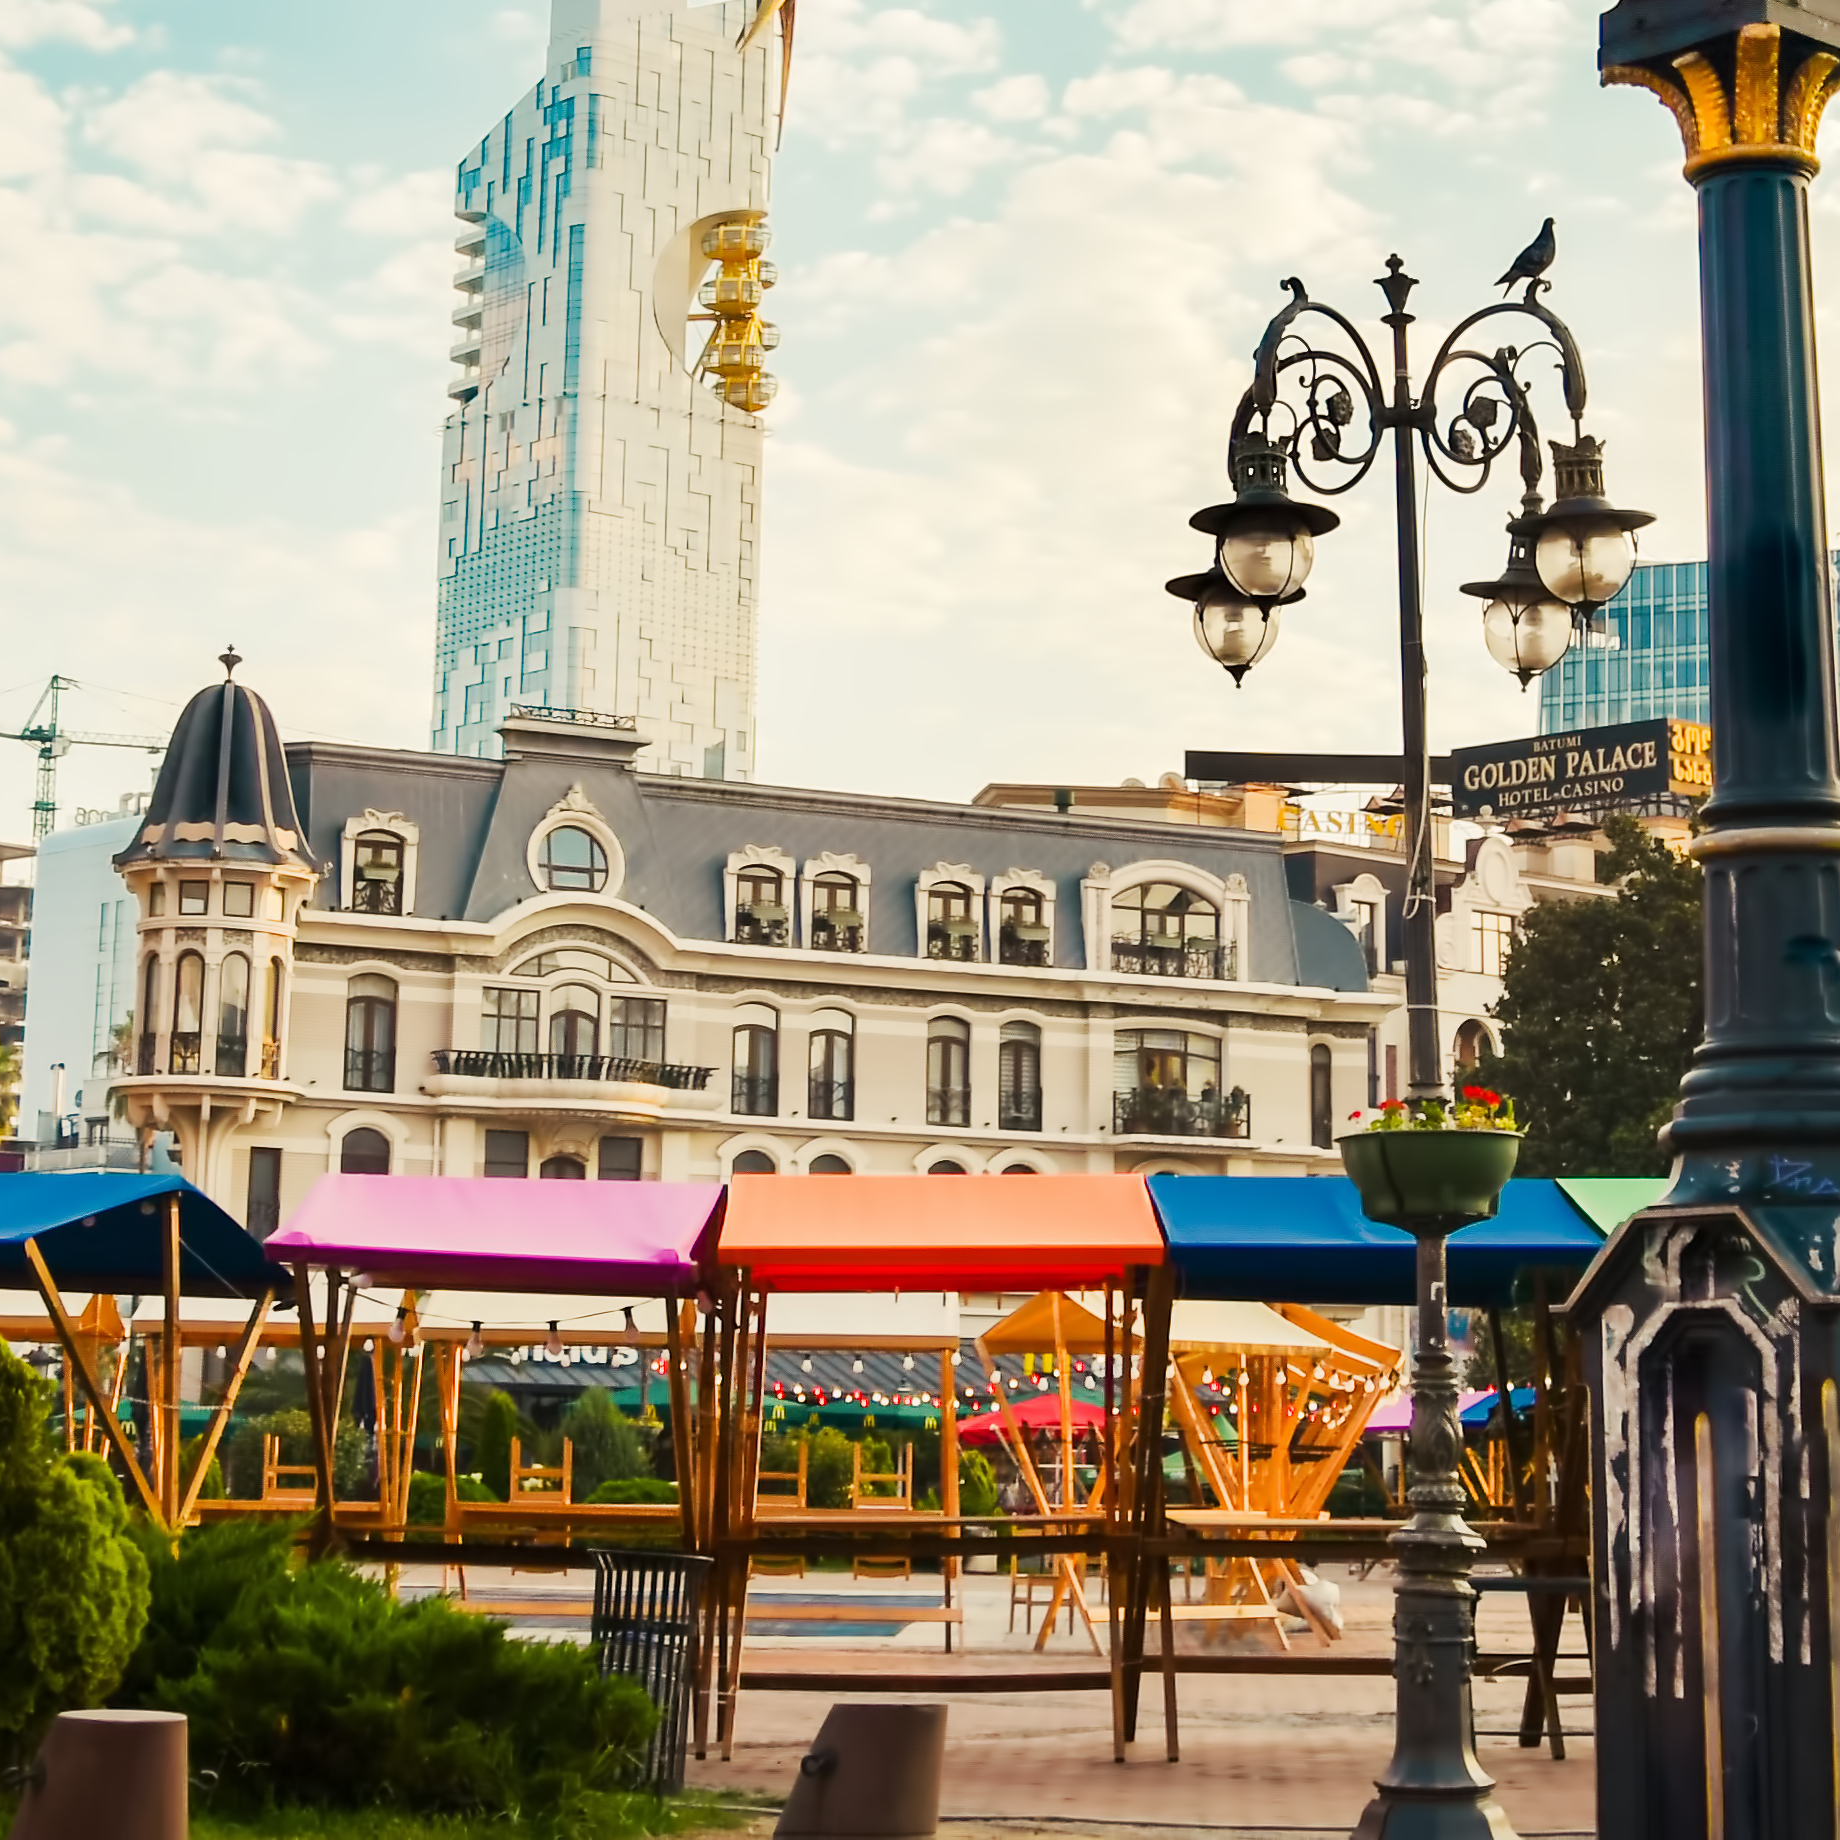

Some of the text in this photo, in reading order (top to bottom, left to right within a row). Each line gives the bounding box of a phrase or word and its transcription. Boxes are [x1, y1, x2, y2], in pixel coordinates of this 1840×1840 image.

[1533, 735, 1582, 753] BATUMI
[1463, 741, 1658, 792] GOLDEN PALACE
[1277, 802, 1406, 838] CASINO
